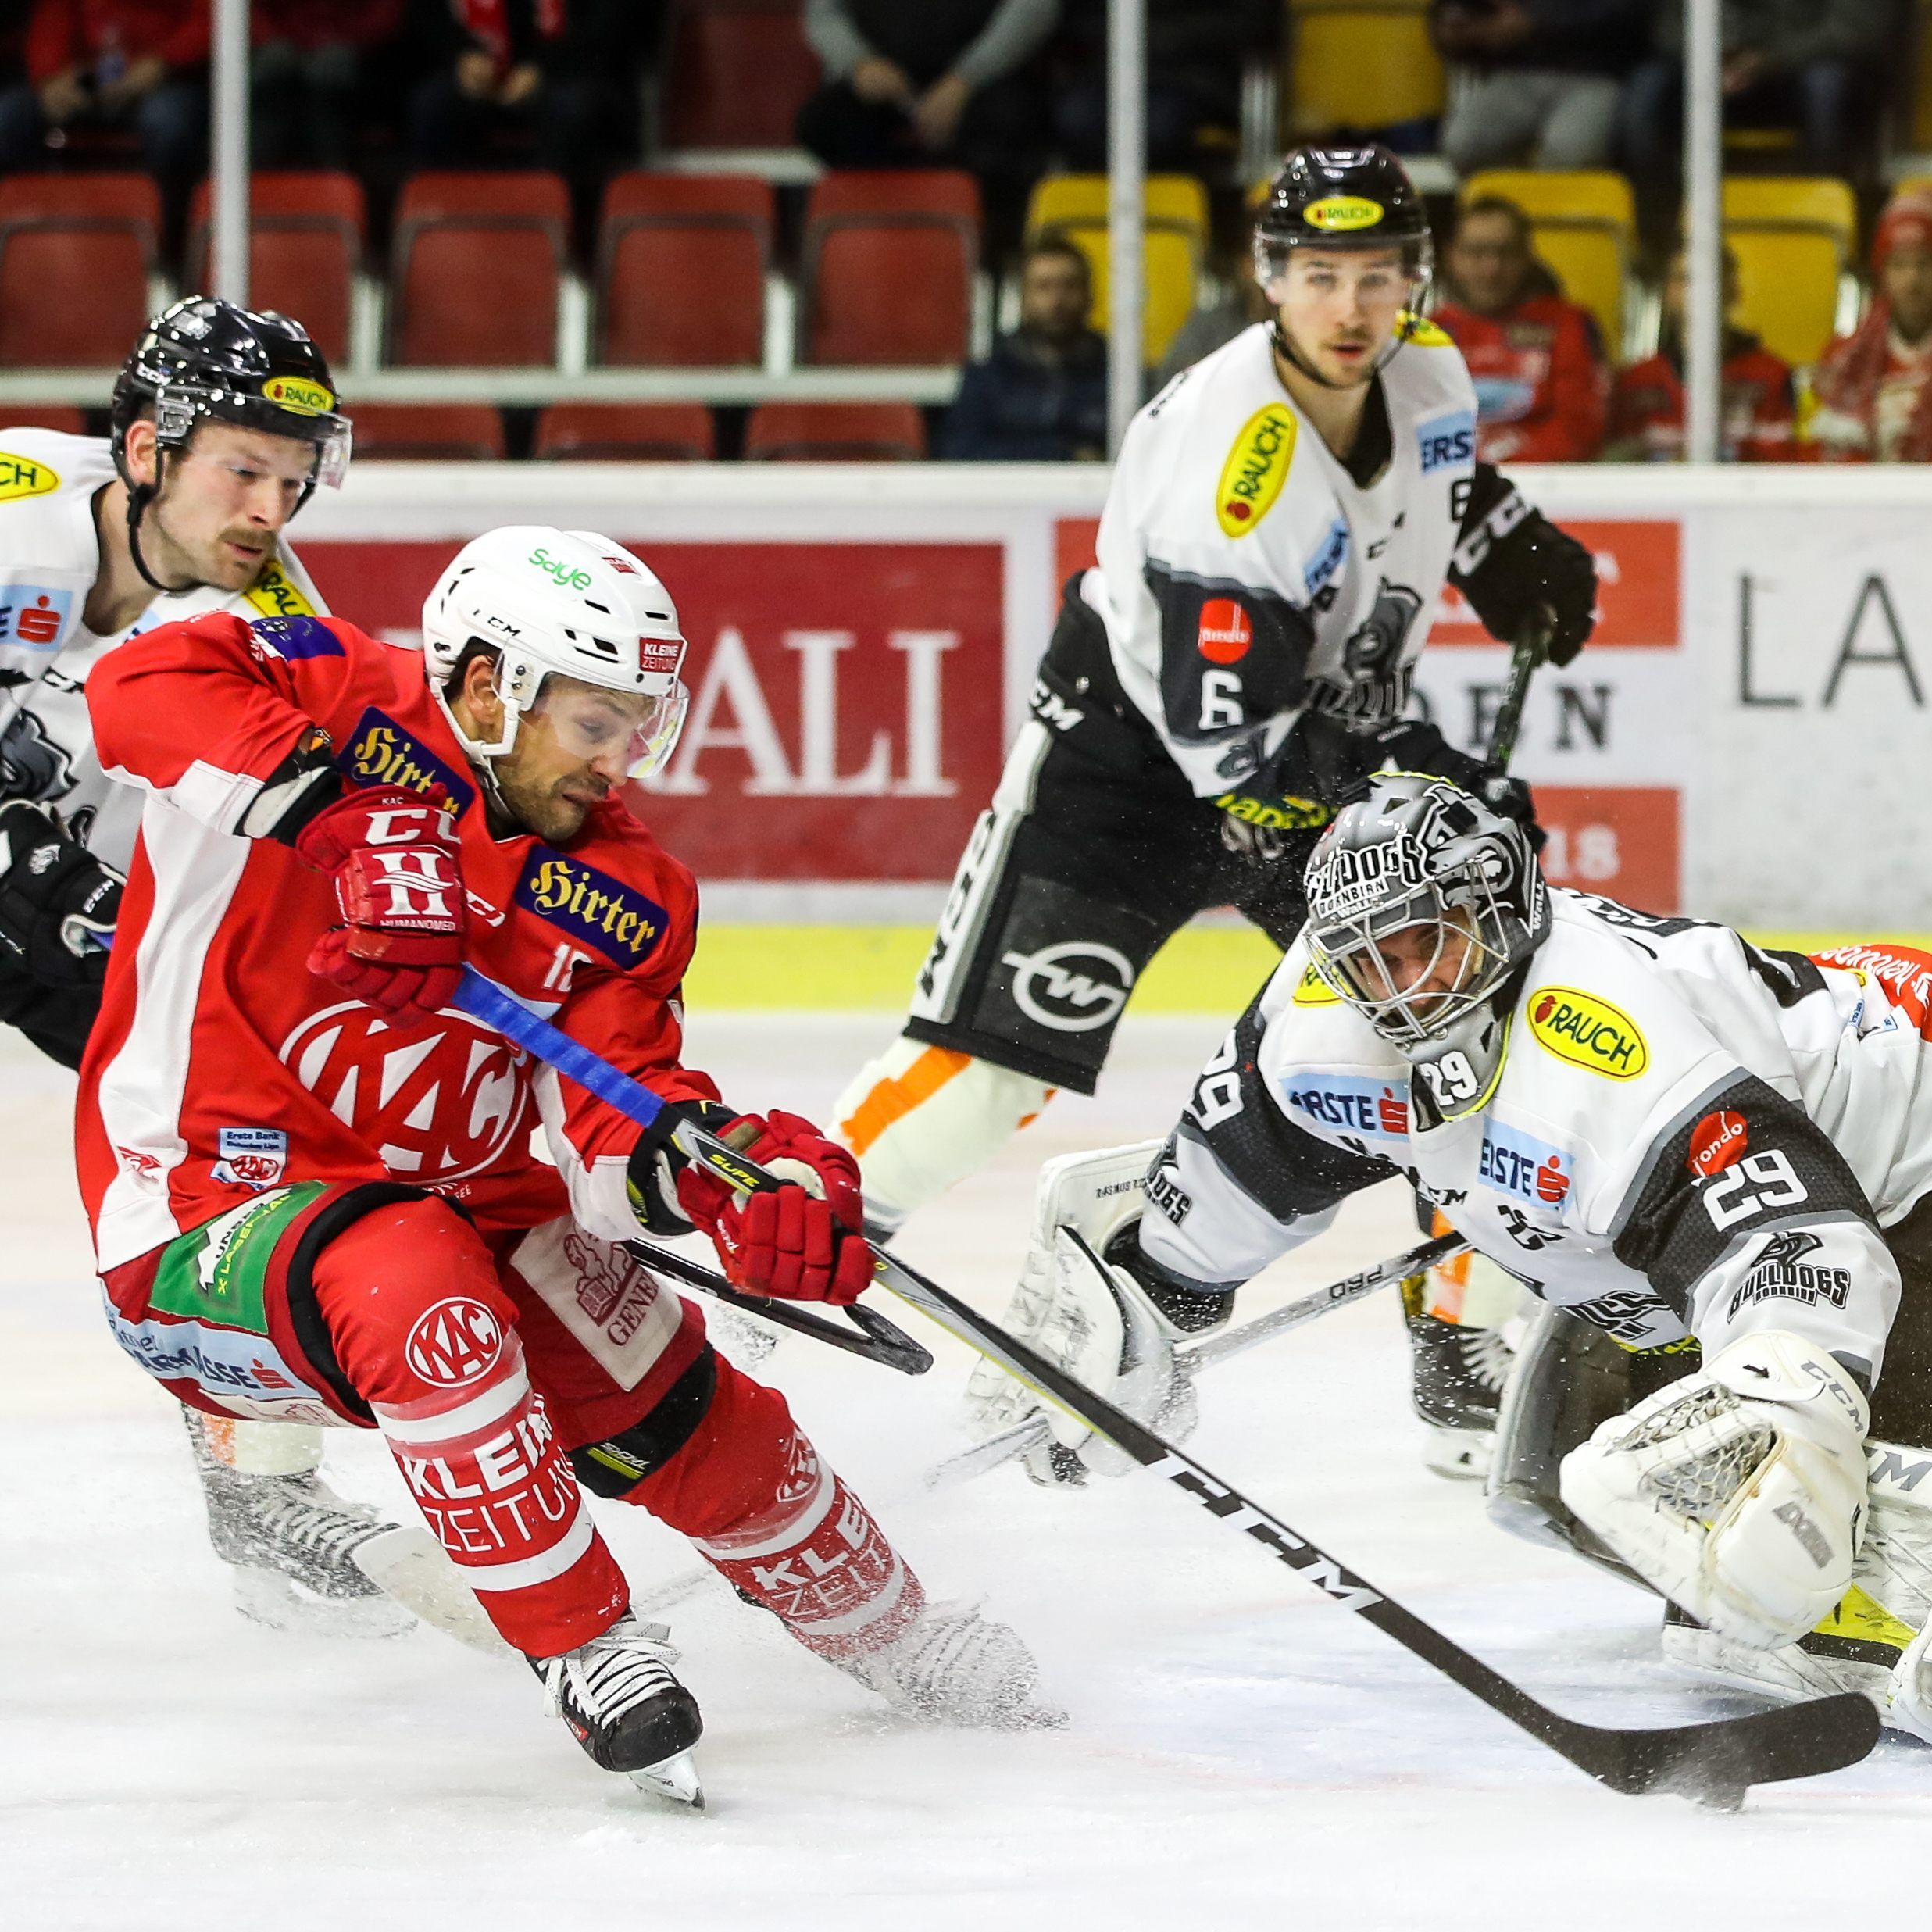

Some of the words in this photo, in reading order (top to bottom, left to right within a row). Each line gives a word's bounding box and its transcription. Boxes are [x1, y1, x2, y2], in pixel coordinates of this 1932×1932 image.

[284, 386, 327, 406] RAUCH
[1234, 415, 1290, 500] RAUCH
[1422, 430, 1473, 473] ERS
[1454, 488, 1529, 578] CC
[261, 570, 308, 617] RAU
[473, 609, 521, 637] CM
[641, 655, 677, 670] ZEITUNG
[643, 643, 679, 657] KLEINE
[639, 625, 961, 798] ALI
[1030, 677, 1085, 732] CM
[1198, 668, 1245, 731] 6
[354, 727, 460, 815] Hirt
[381, 795, 405, 805] KAC
[364, 809, 462, 845] CC
[1305, 833, 1423, 903] DOGS
[1318, 878, 1386, 916] DORNBIRN
[380, 919, 456, 933] HUMANOMED
[530, 861, 655, 954] Hirter
[1546, 1003, 1637, 1071] RAUCH
[1418, 1051, 1478, 1107] 29
[227, 1131, 254, 1141] Erste
[255, 1131, 280, 1141] Bank
[709, 1153, 760, 1188] SUPE
[1095, 1180, 1132, 1199] RASMUS
[1427, 1187, 1469, 1206] CM
[1700, 1148, 1809, 1233] 29
[1329, 1265, 1383, 1300] PRO
[1727, 1261, 1852, 1325] BULLDOGS
[411, 1302, 498, 1382] KAC
[1800, 1359, 1864, 1433] CCM
[402, 1393, 552, 1501] KLEIN
[423, 1445, 577, 1553] ZEITUN
[750, 1491, 870, 1591] KLE
[1144, 1448, 1384, 1612] CCM
[770, 1534, 887, 1617] ZEIT
